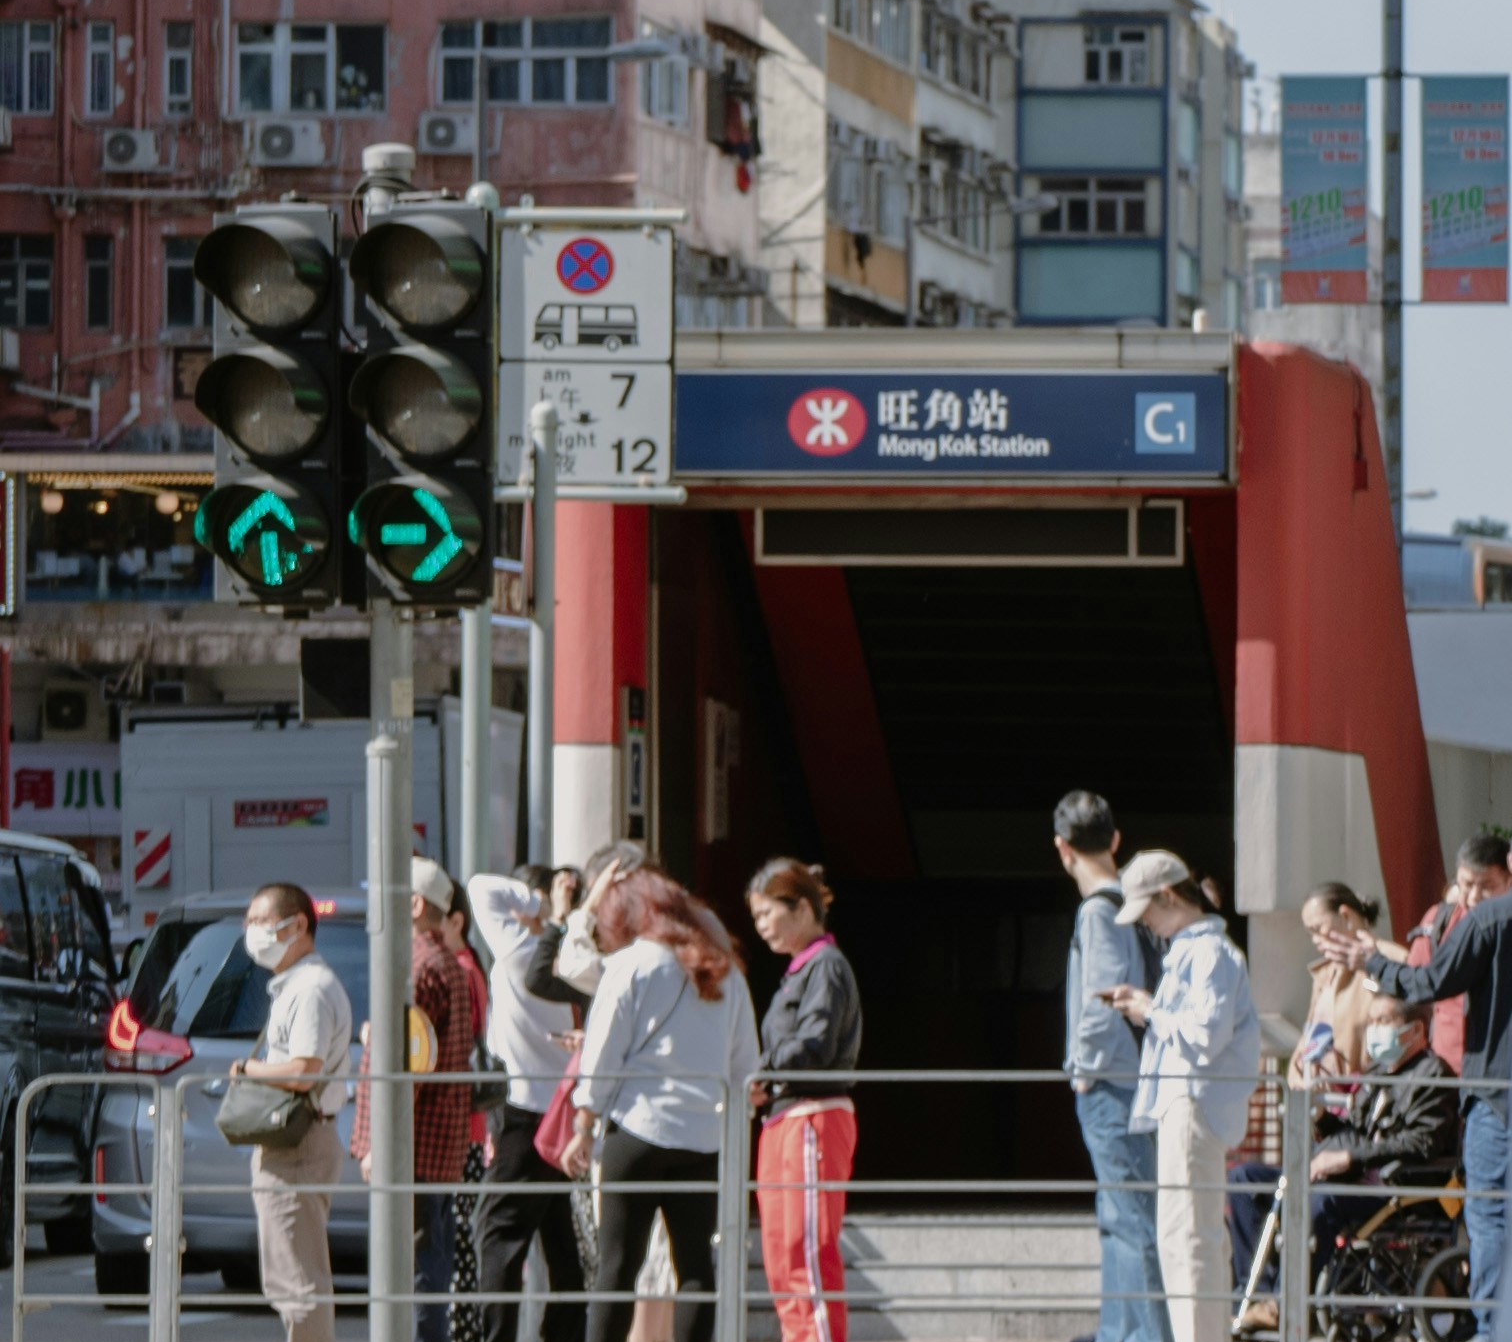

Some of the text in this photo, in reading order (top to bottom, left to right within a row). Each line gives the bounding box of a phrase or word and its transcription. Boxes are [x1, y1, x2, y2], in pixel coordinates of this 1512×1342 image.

[1289, 187, 1341, 222] 1210
[1430, 185, 1483, 220] 1210
[543, 370, 572, 382] am
[611, 373, 637, 409] 7
[878, 389, 1008, 432] 旺角站
[508, 431, 597, 449] might
[612, 438, 656, 474] 12
[878, 434, 1049, 461] Mong Kok Station
